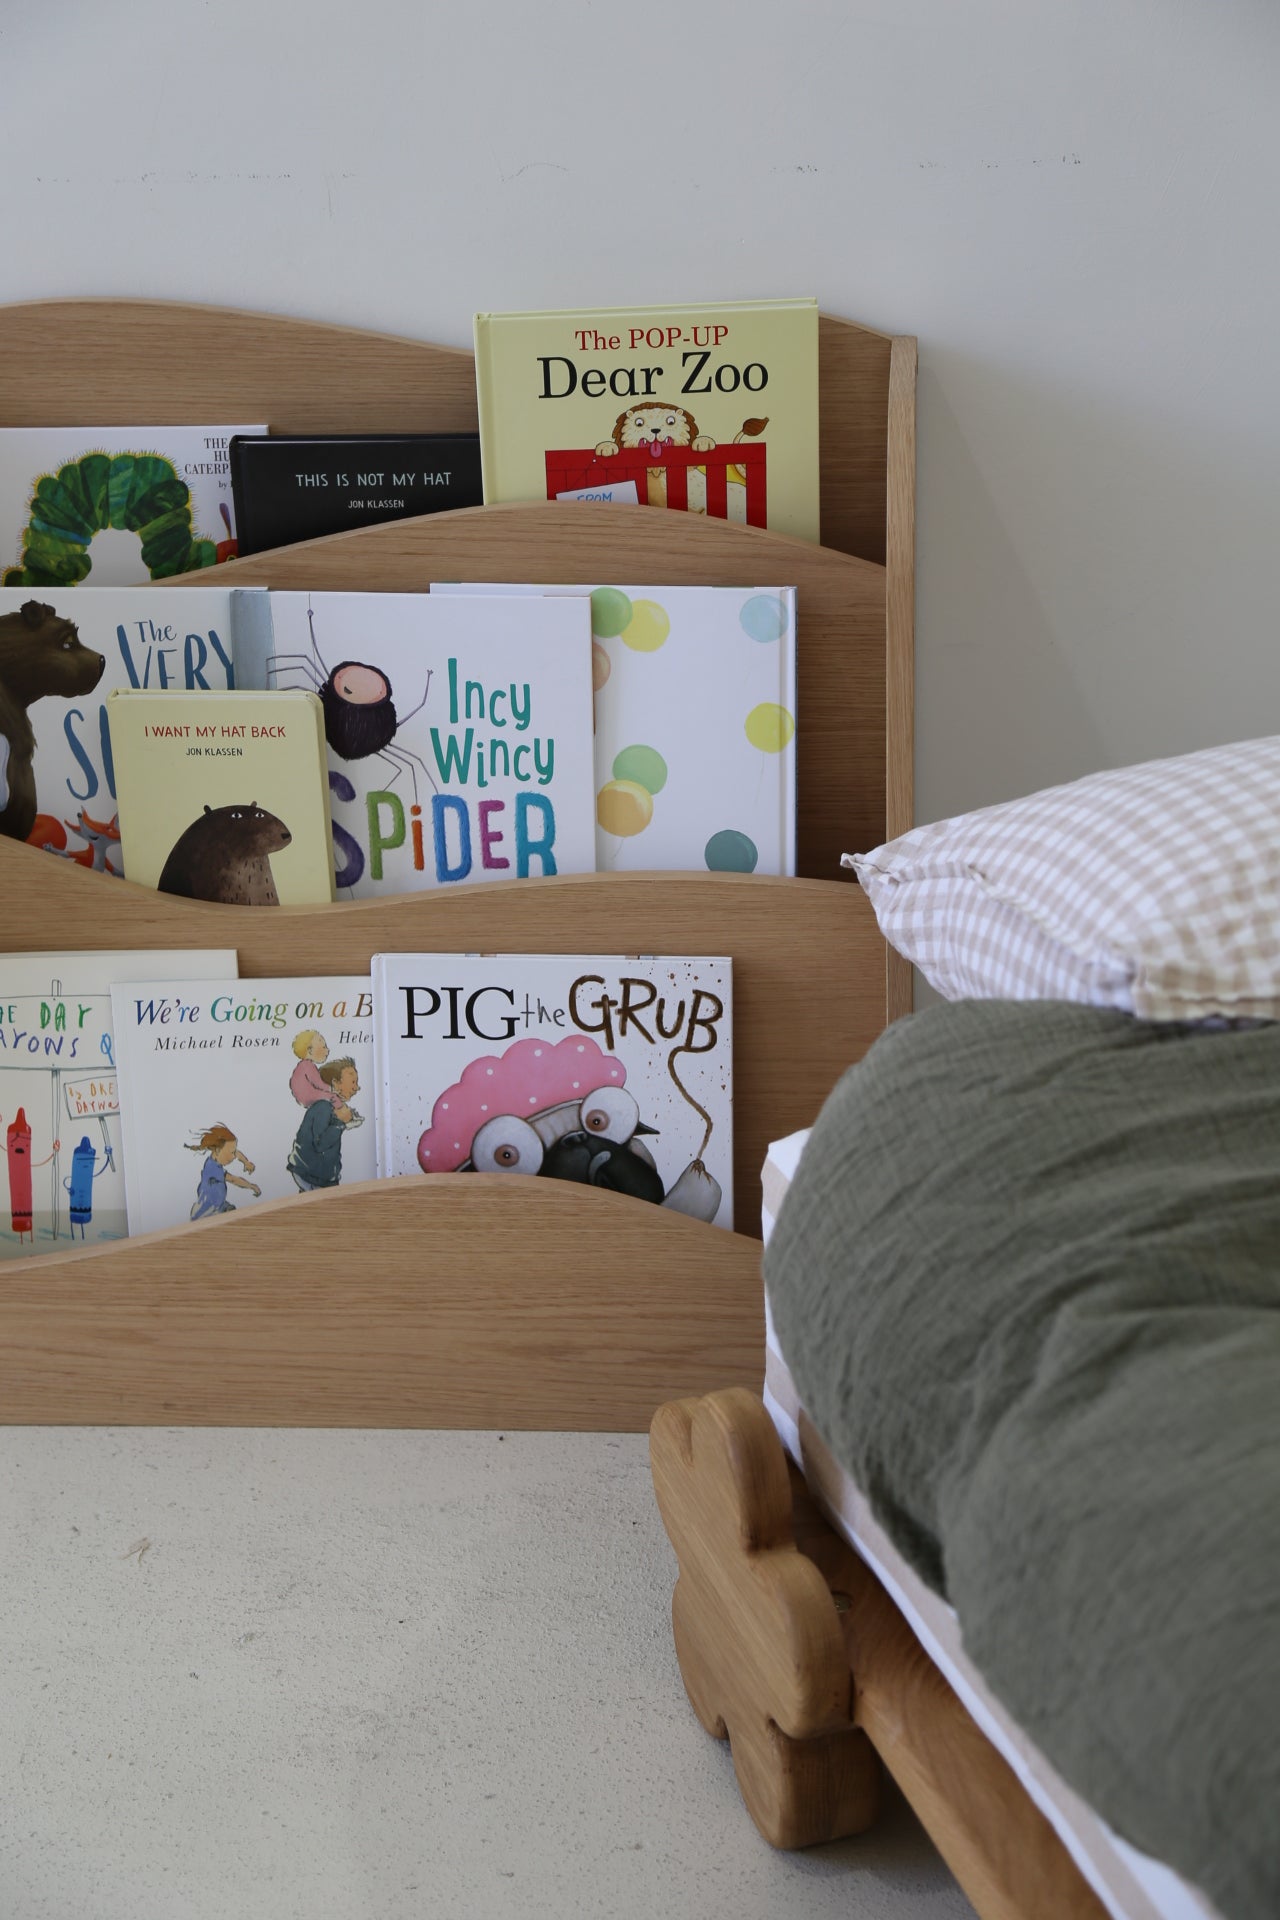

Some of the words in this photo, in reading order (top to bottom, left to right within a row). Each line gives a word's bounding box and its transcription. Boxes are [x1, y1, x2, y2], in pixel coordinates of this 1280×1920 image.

[575, 330, 621, 351] The
[628, 325, 729, 350] POP-UP
[537, 356, 664, 399] Dear
[680, 351, 769, 394] Zoo
[203, 437, 229, 449] THE
[184, 463, 229, 475] CATERP
[218, 480, 227, 490] by
[295, 473, 329, 487] THIS
[337, 473, 350, 487] IS
[357, 473, 385, 487] NOT
[392, 473, 416, 486] MY
[423, 472, 452, 486] HAT
[348, 500, 364, 509] JON
[367, 499, 405, 508] KLASSEN
[133, 619, 177, 643] The
[447, 657, 531, 731] Incy
[144, 726, 149, 737] I
[151, 726, 191, 737] WANT
[195, 726, 217, 737] MY
[221, 726, 247, 738] HAT
[251, 726, 286, 738] BACK
[186, 747, 202, 756] JON
[204, 747, 243, 756] KLASSEN
[429, 727, 555, 788] Wincy
[39, 1001, 93, 1032] DAY
[135, 998, 200, 1026] We're
[210, 996, 289, 1029] Going
[295, 1001, 324, 1019] on
[332, 1001, 347, 1018] a
[398, 986, 520, 1041] PIG
[520, 992, 566, 1029] the
[568, 974, 724, 1054] GRUB
[154, 1034, 223, 1051] Michael
[231, 1034, 280, 1048] Rosen
